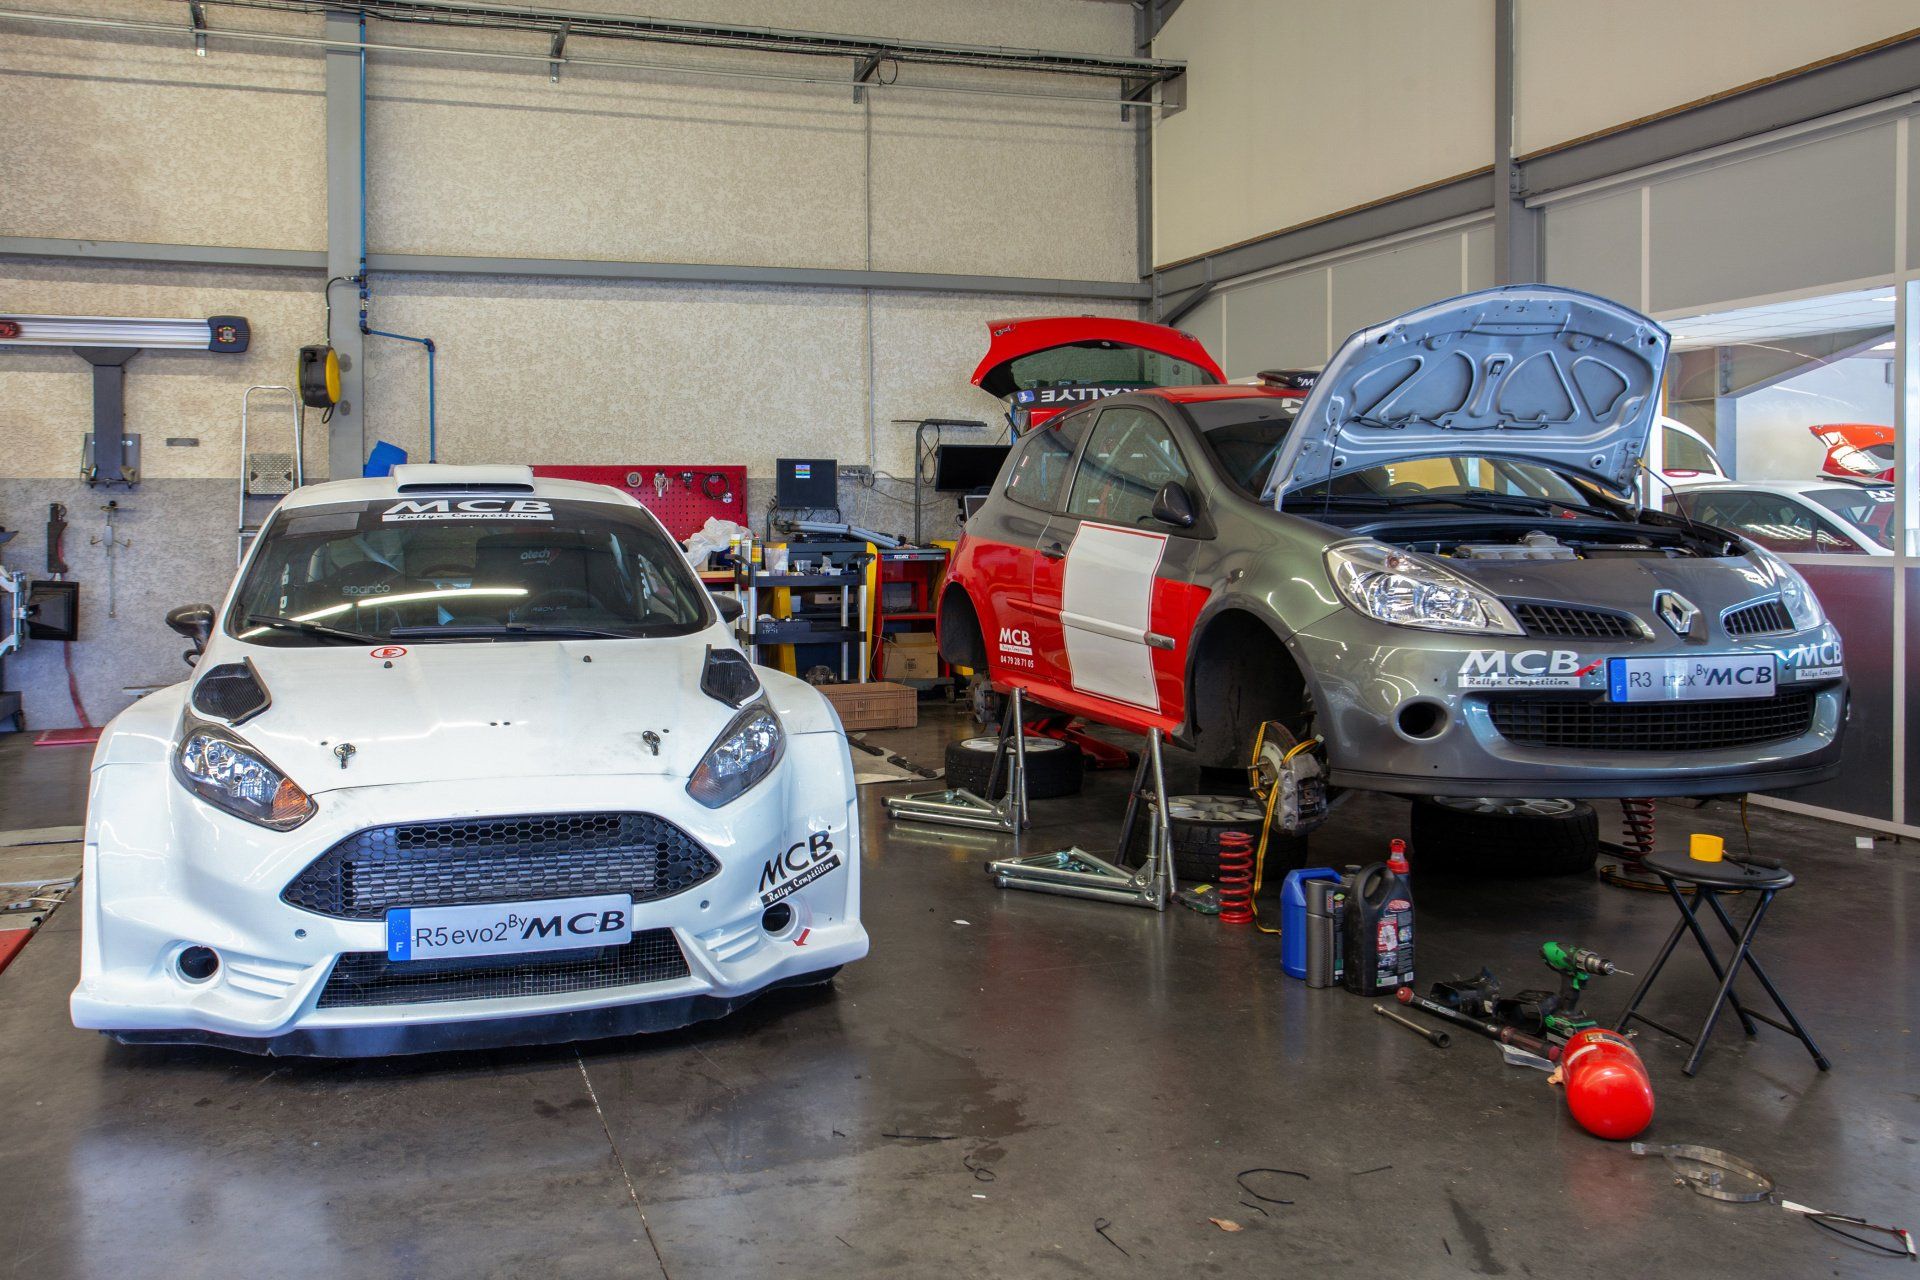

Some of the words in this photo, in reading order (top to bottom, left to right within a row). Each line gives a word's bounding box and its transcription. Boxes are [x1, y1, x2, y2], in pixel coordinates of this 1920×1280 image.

[382, 500, 552, 514] MCB
[342, 583, 391, 594] sparco
[999, 627, 1031, 646] MCB
[1458, 650, 1580, 675] MCB
[1796, 642, 1842, 666] MCB
[1468, 677, 1502, 687] Rallye
[1629, 672, 1652, 688] R3
[1662, 675, 1697, 688] max
[1696, 663, 1709, 678] By
[1705, 666, 1772, 686] MCB
[759, 830, 834, 893] MCB
[767, 884, 793, 902] Rallye
[396, 942, 404, 952] F
[509, 914, 527, 931] By
[521, 910, 625, 940] MCB
